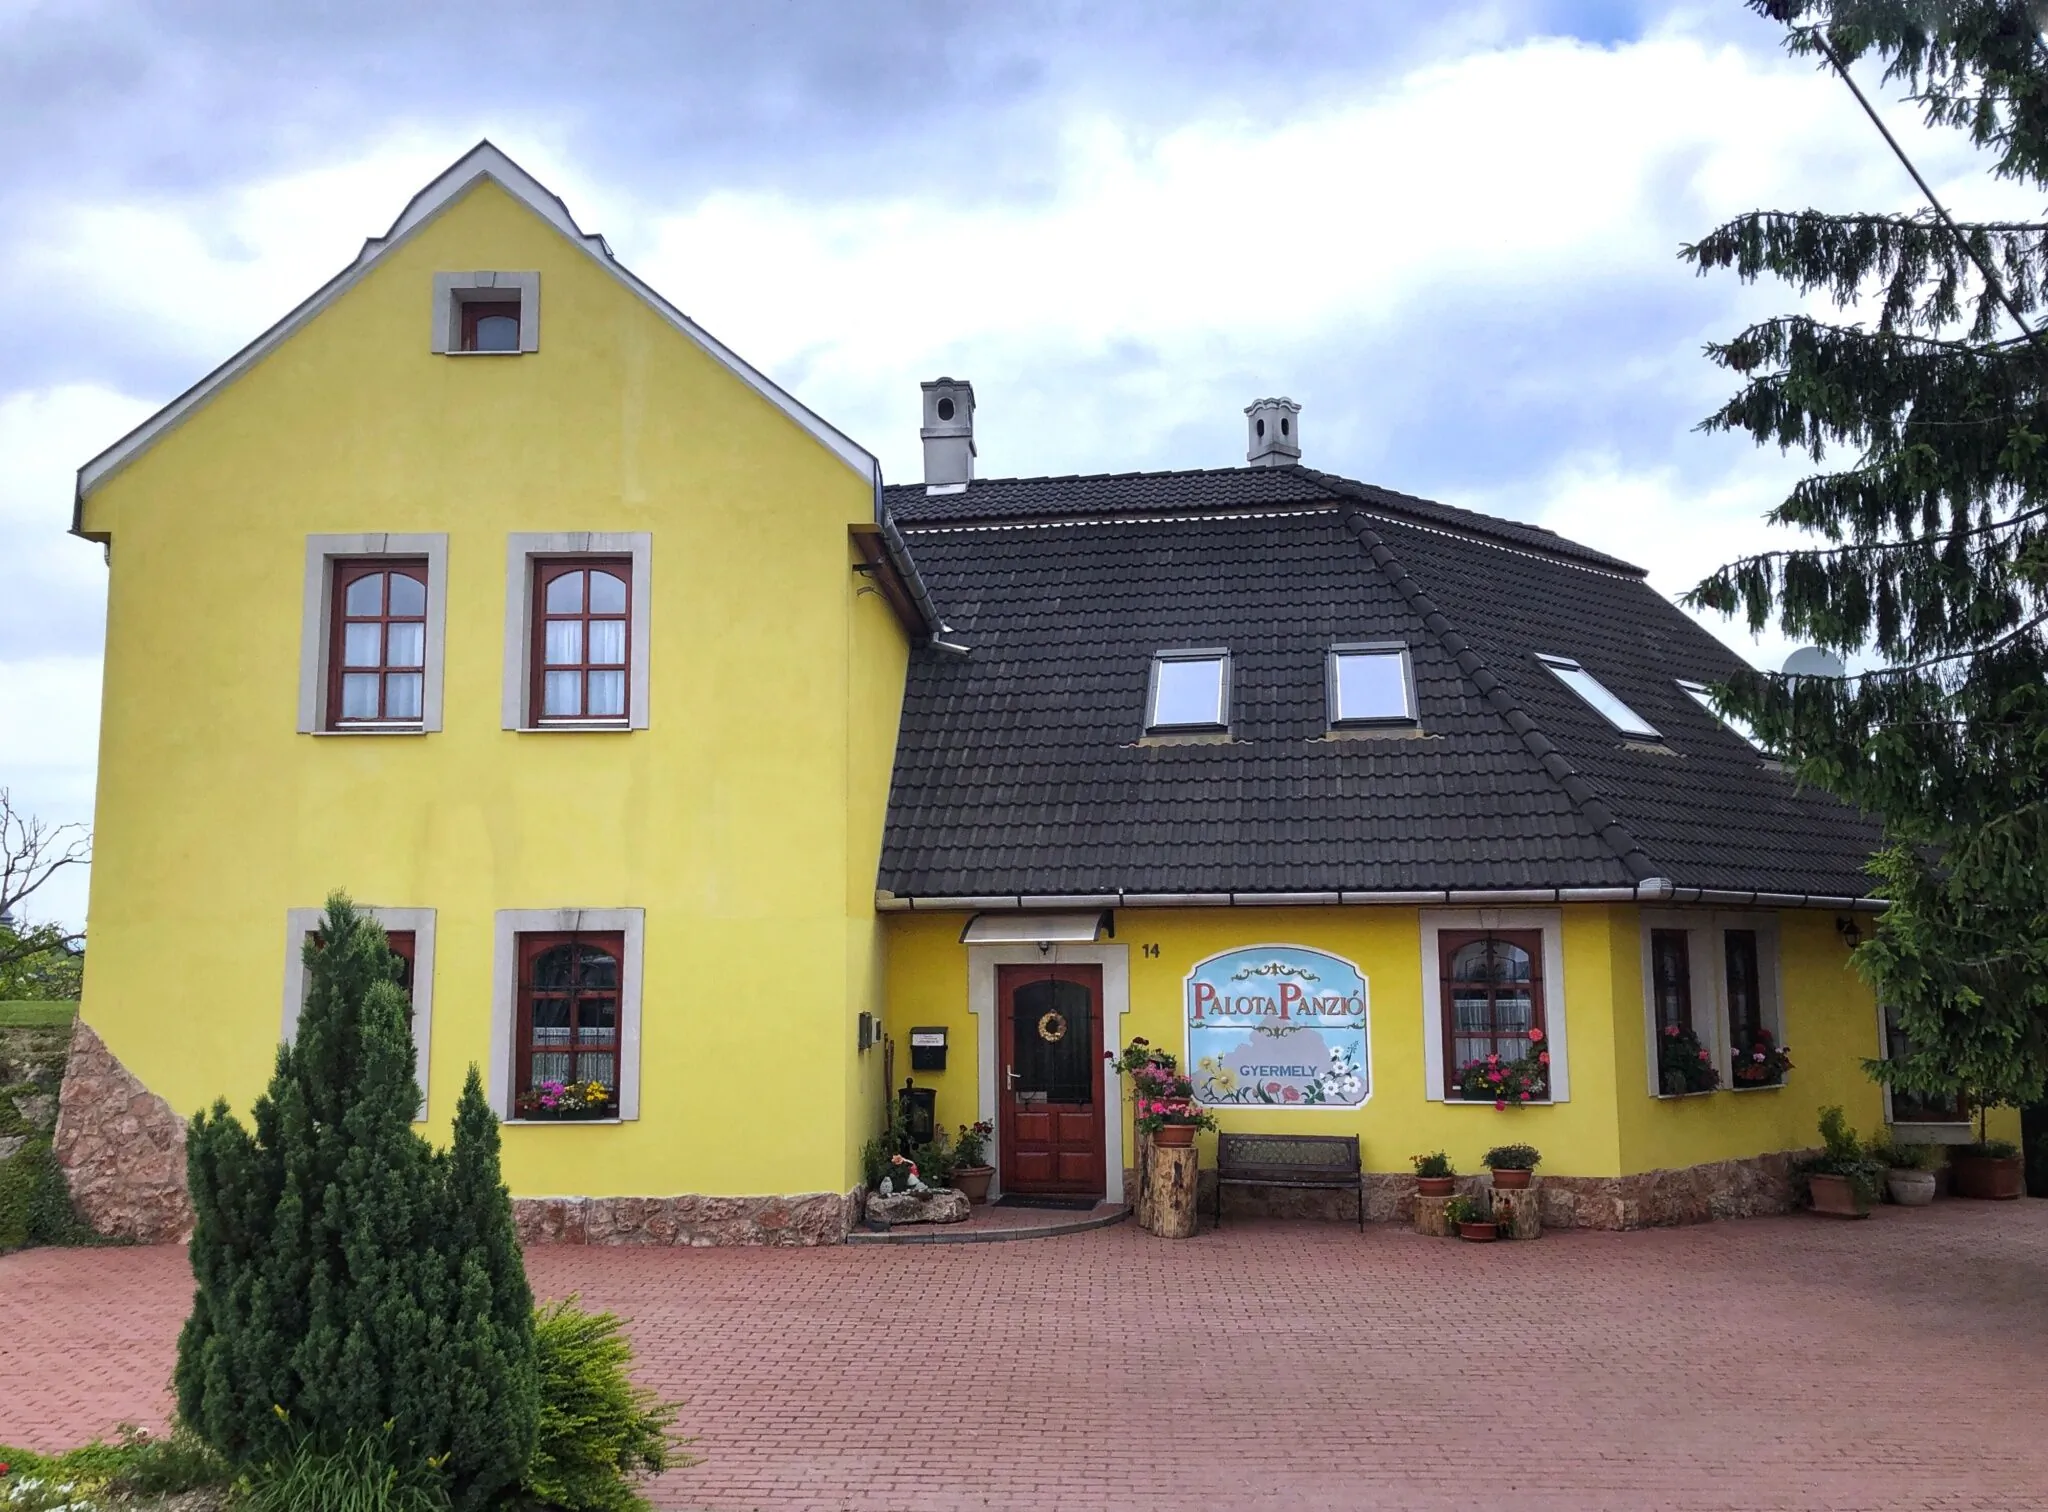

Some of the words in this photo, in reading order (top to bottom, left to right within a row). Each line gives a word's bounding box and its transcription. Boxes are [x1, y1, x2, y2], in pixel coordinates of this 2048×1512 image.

[1142, 943, 1160, 958] 14
[1192, 982, 1278, 1020] PALOTA
[1277, 982, 1364, 1020] PANZIÓ
[1239, 1065, 1318, 1077] GYERMELY
